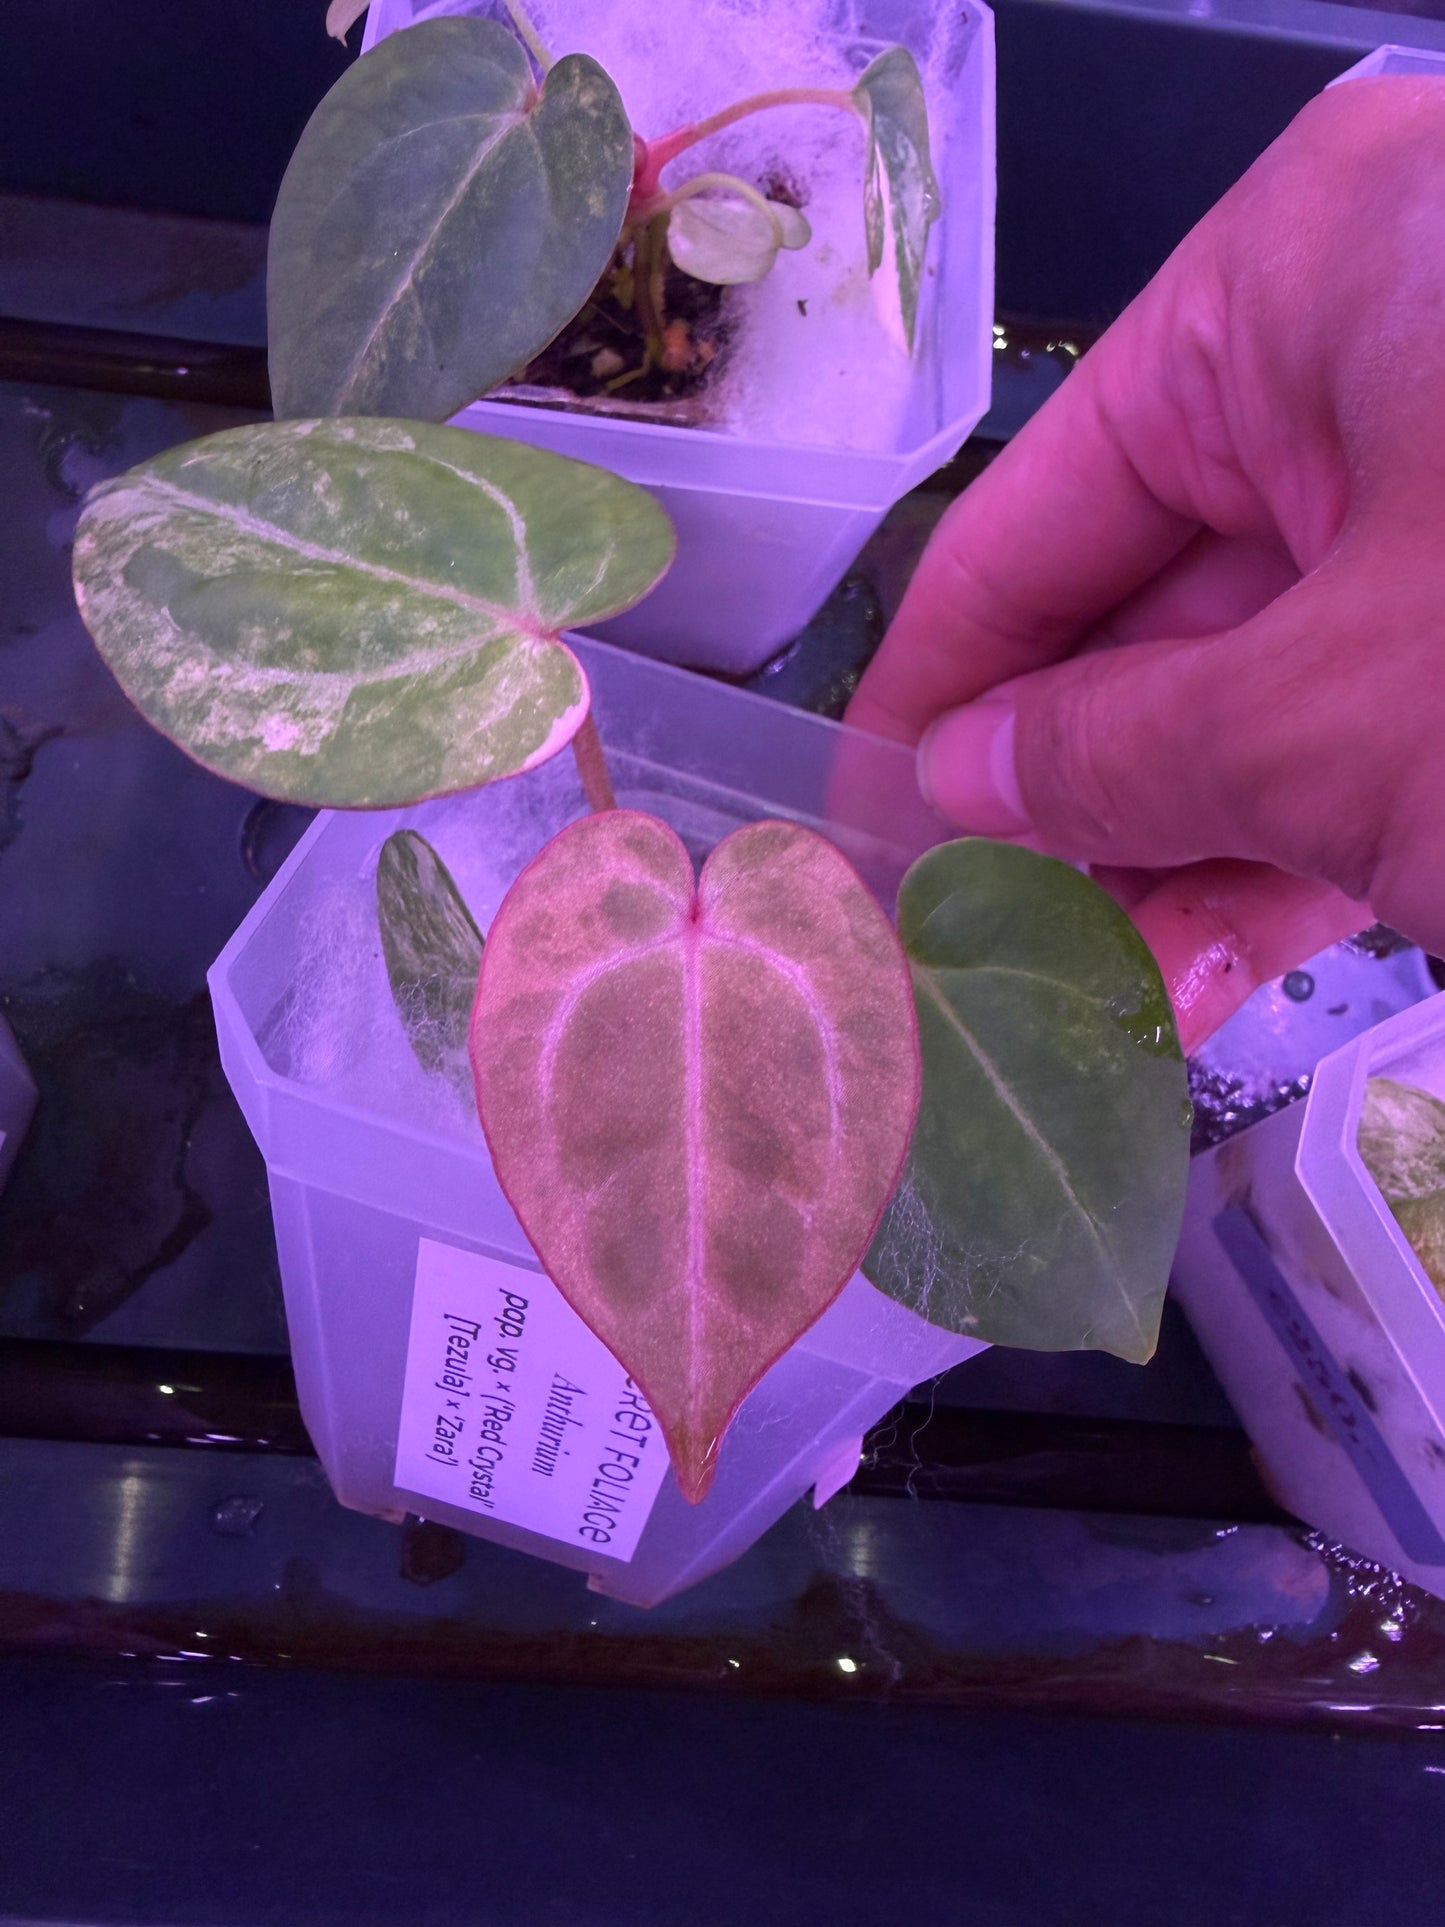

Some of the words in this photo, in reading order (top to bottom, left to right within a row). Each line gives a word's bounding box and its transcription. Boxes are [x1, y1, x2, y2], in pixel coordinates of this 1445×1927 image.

[494, 1287, 529, 1339] pap.
[435, 1313, 482, 1397] [Tezula]
[487, 1348, 519, 1374] vg.
[531, 1372, 588, 1477] Anthurium
